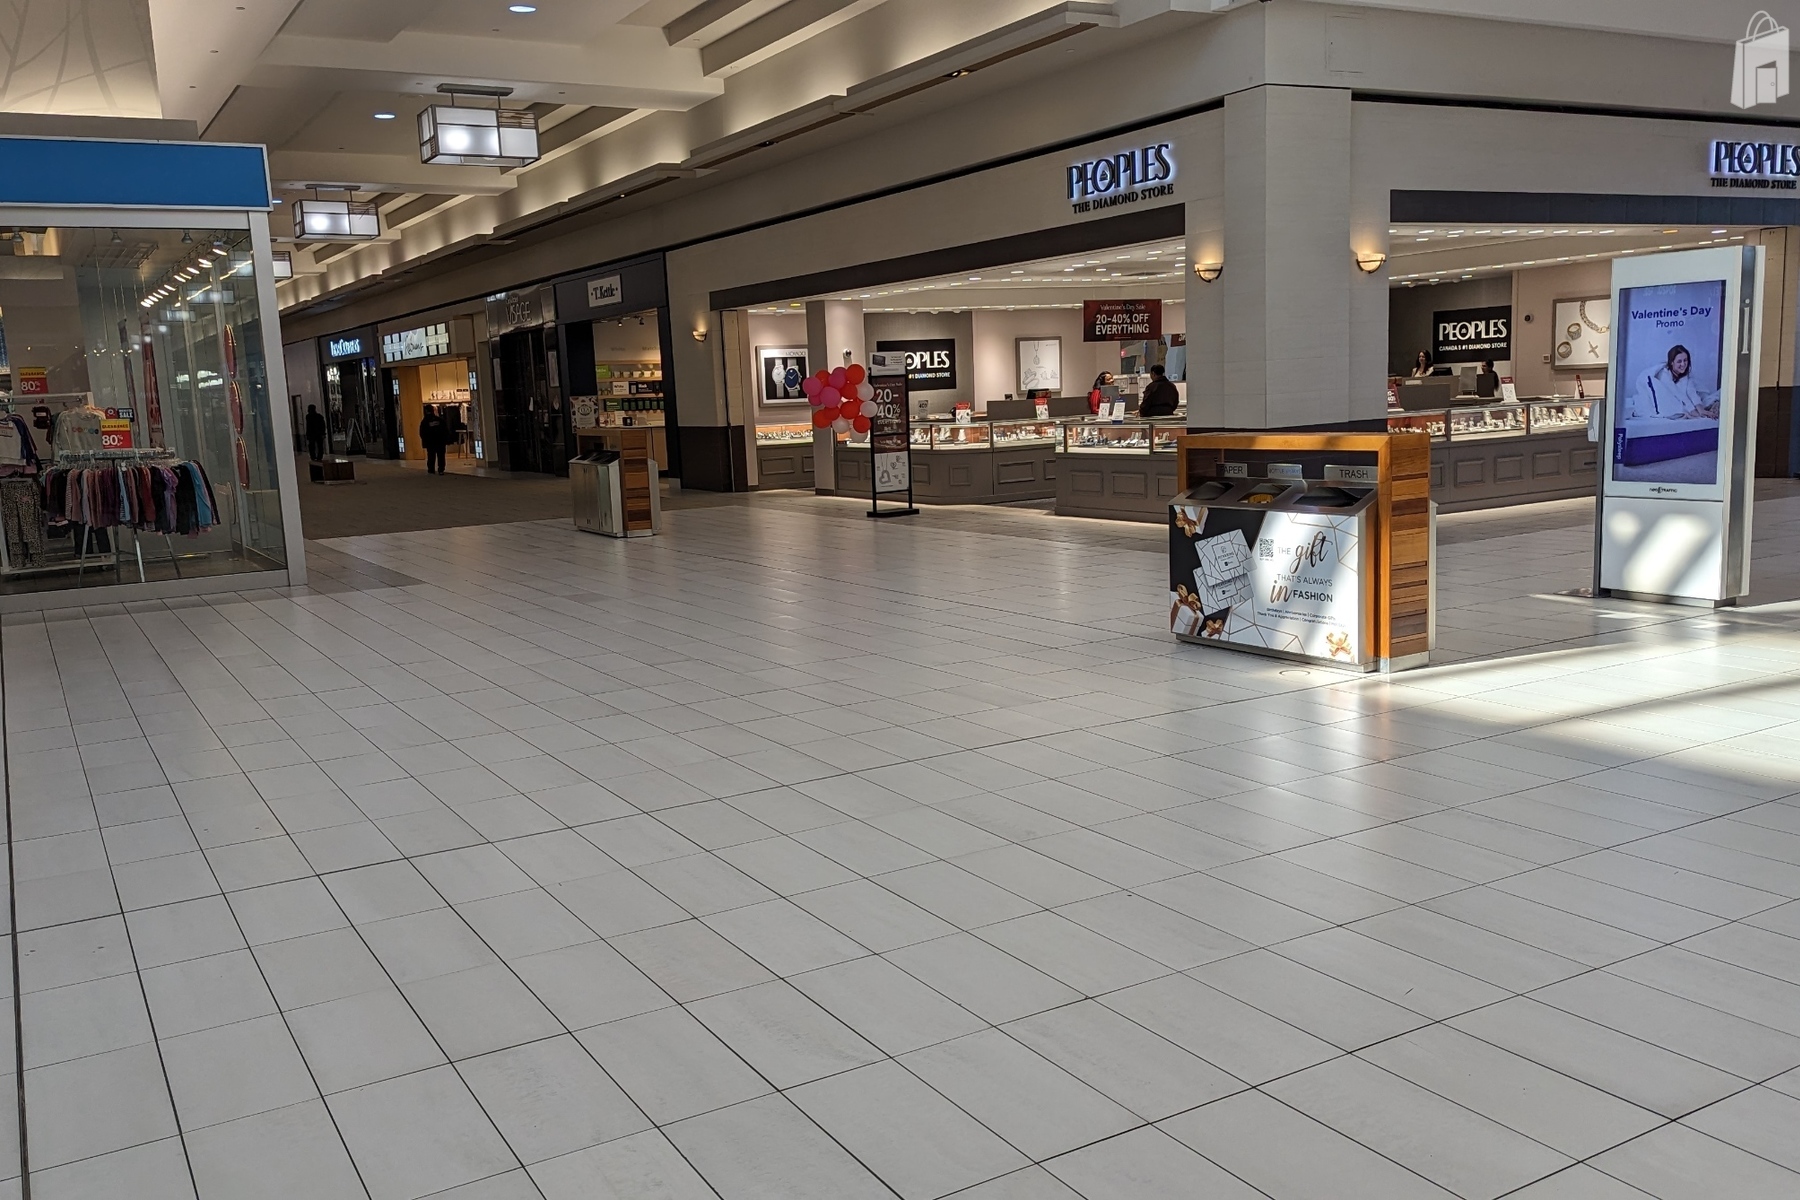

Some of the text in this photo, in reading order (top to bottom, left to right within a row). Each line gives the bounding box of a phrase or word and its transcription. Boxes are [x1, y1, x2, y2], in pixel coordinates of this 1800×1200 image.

[1713, 141, 1800, 176] PEOPLES
[1066, 143, 1172, 199] PEOPLES
[1710, 178, 1797, 190] THE DIAMOND STORE
[1072, 183, 1174, 214] THE DIAMOND STORE
[1100, 303, 1126, 311] Valentine's
[1631, 306, 1711, 319] Valentine's Day
[1096, 313, 1149, 324] 20-40% OFF
[1656, 319, 1684, 328] Promo
[1095, 323, 1149, 336] EVERYTHING
[1438, 319, 1507, 341] PEOPLES
[1468, 342, 1491, 350] DIAMOND
[1491, 341, 1507, 349] STORE
[905, 350, 950, 370] OPLES
[876, 388, 899, 402] 20-
[877, 403, 900, 418] 40%
[1221, 465, 1243, 475] PAPER
[1339, 469, 1369, 479] TRASH
[1278, 531, 1333, 575] THE gift
[1277, 573, 1333, 588] THAT'S ALWAYS
[1270, 580, 1333, 603] in FASHION
